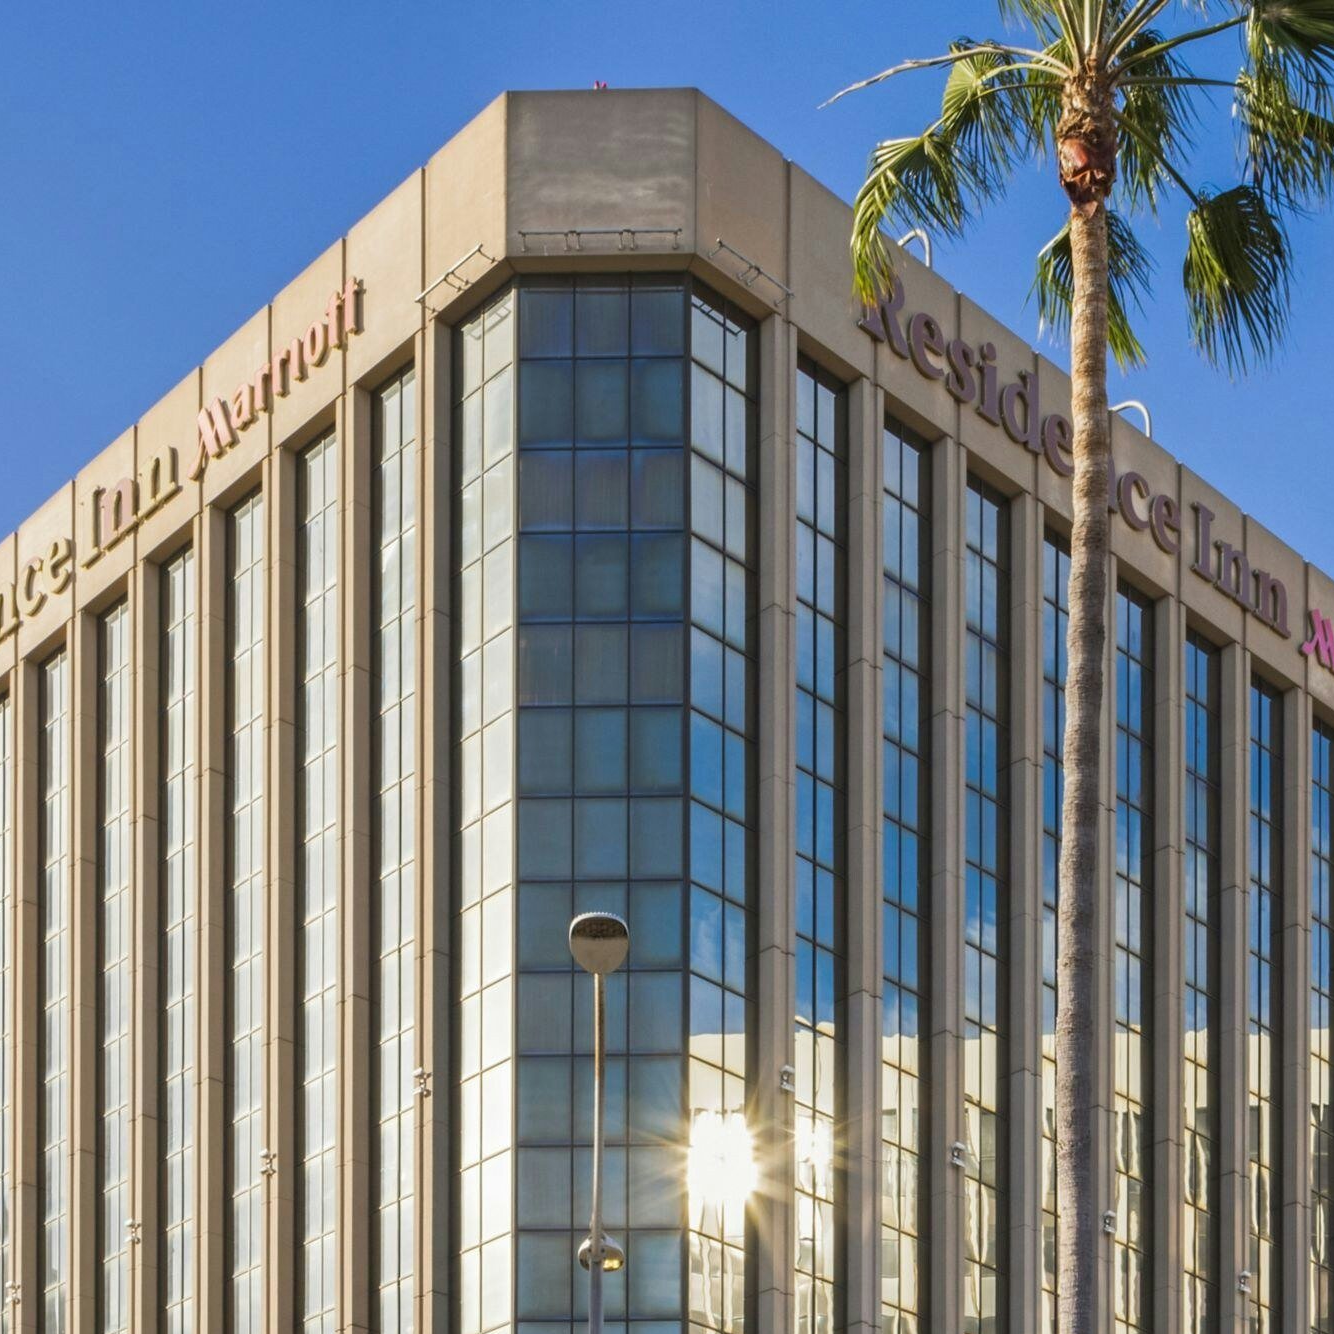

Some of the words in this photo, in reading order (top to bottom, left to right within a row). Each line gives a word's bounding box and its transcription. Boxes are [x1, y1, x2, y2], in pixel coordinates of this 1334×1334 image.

[78, 445, 182, 570] Inn
[188, 276, 366, 481] Marriott
[857, 272, 1182, 555] Residece
[1190, 501, 1291, 639] Inn
